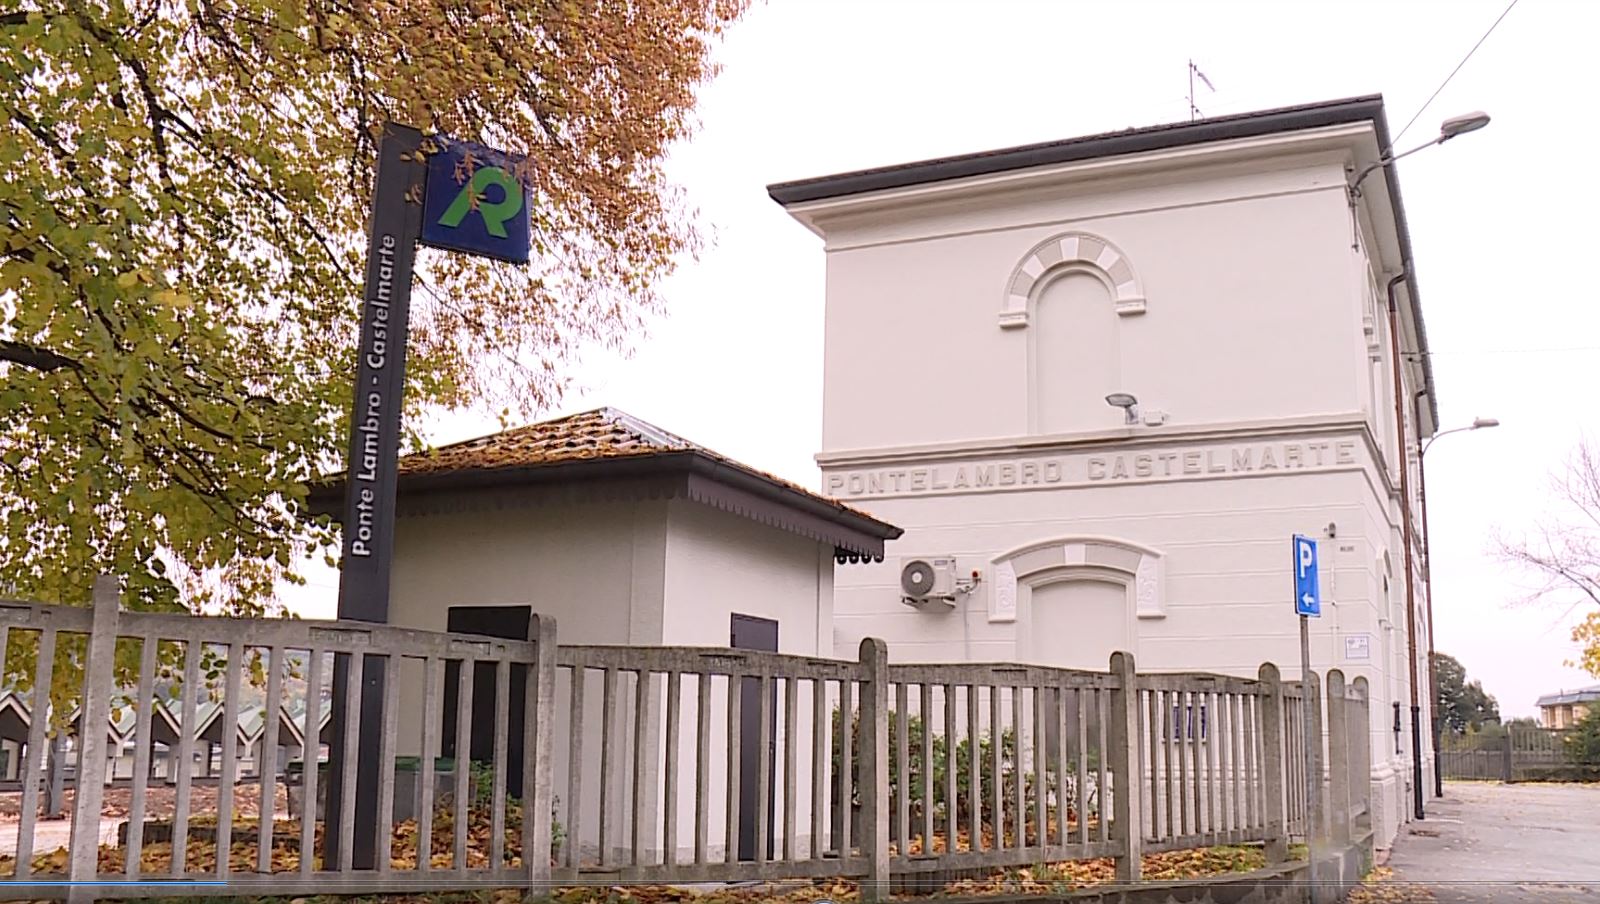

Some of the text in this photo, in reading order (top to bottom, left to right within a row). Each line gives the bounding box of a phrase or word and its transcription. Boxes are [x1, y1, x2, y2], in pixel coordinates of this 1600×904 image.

[366, 235, 396, 370] Castelmarte
[359, 393, 381, 481] Lambro
[828, 441, 1355, 496] PONTELAMBRO CASTELMARTE
[352, 488, 374, 557] Ponte
[1299, 541, 1313, 578] P
